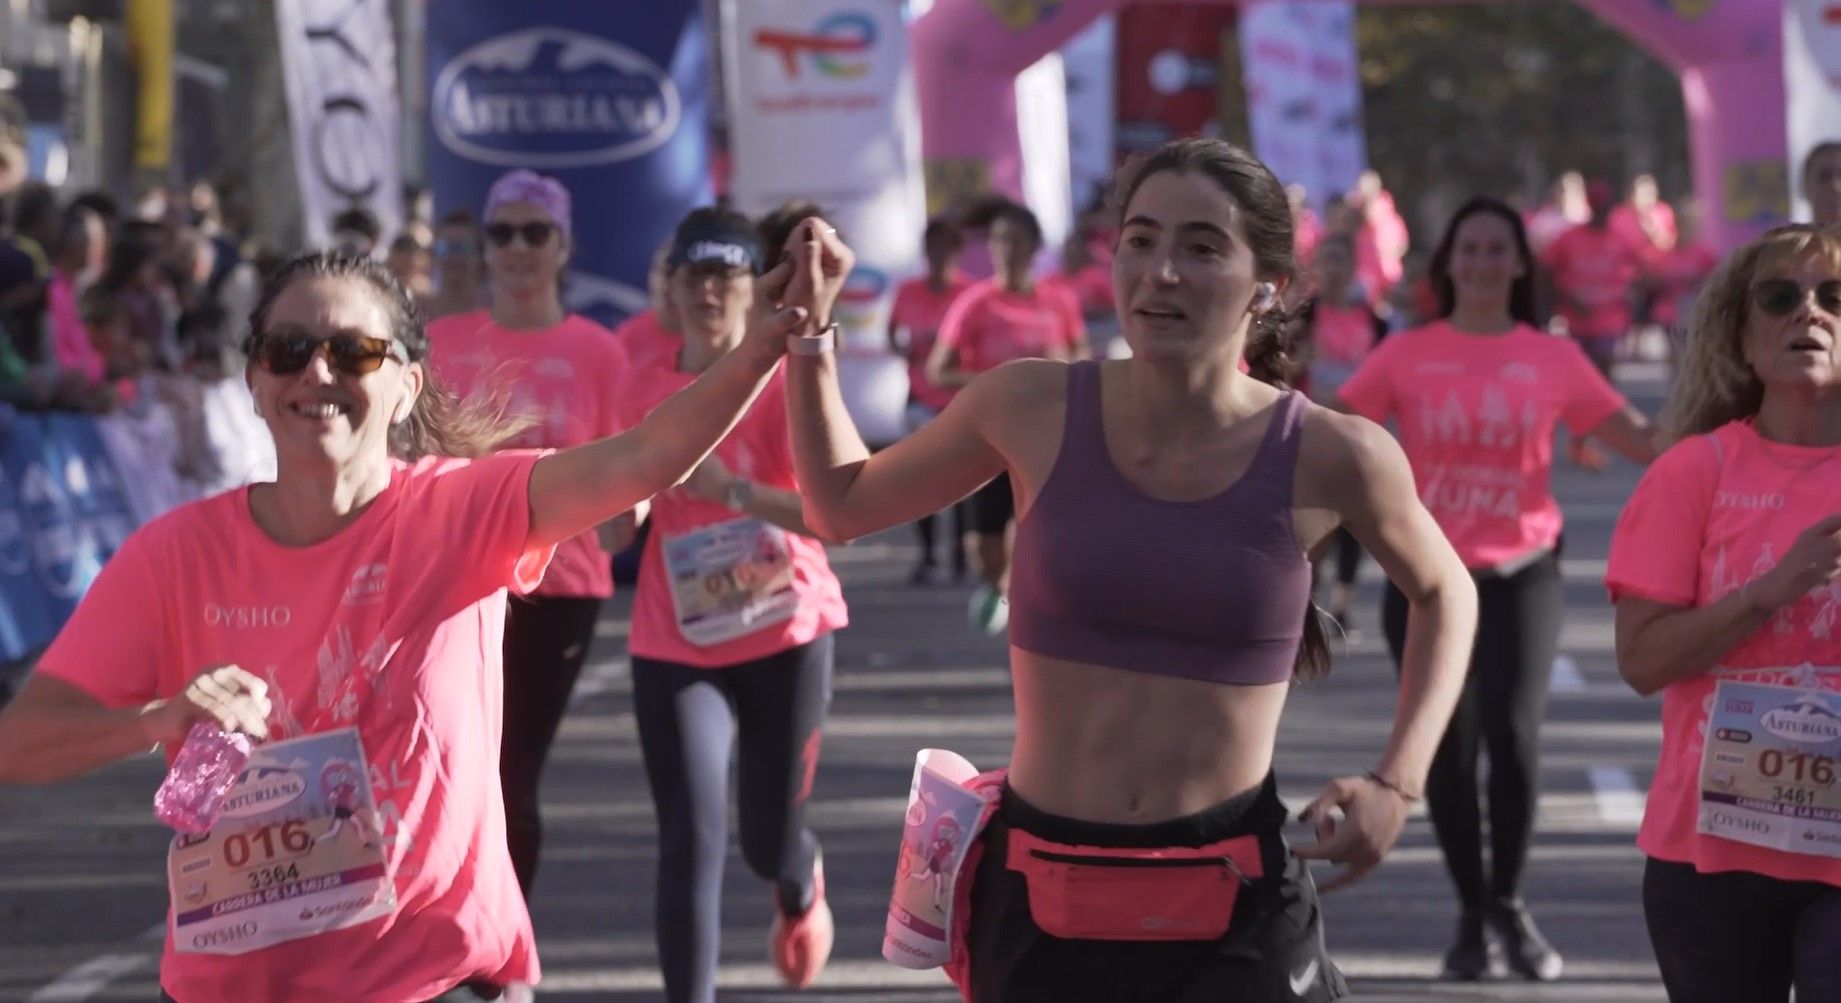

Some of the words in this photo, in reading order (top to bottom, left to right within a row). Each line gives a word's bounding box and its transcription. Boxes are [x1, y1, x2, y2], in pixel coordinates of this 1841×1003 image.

[203, 603, 291, 628] OYSHO
[1764, 713, 1839, 738] ASTURIANA
[1758, 748, 1836, 785] 016
[1772, 785, 1816, 805] 3461
[1713, 811, 1770, 834] OYSHO
[1781, 803, 1795, 816] DE
[1798, 806, 1810, 818] LA
[222, 819, 311, 868] 016
[247, 862, 300, 889] 3364
[263, 886, 283, 903] DE
[282, 882, 300, 898] LA
[192, 920, 258, 949] OYSHO
